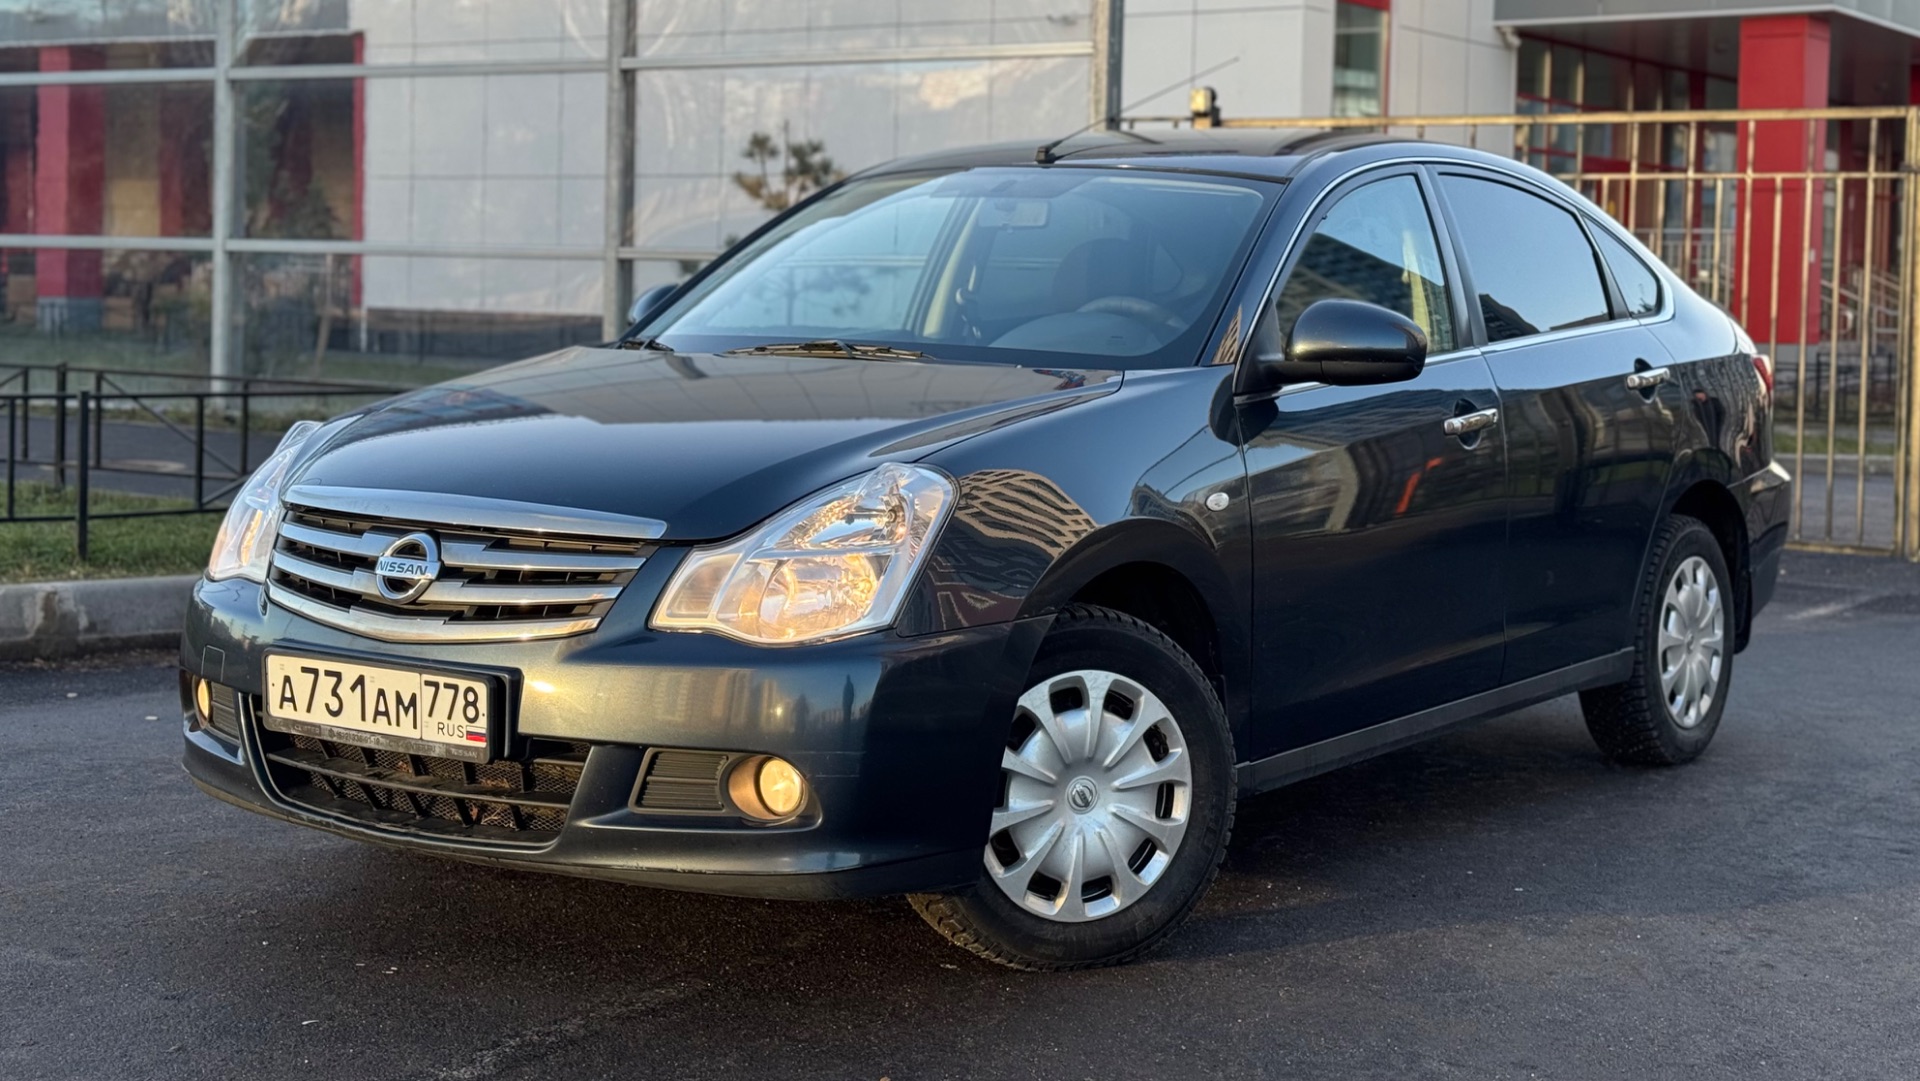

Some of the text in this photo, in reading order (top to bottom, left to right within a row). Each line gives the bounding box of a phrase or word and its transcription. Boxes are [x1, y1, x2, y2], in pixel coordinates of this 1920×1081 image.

[378, 560, 428, 576] NISSAN
[279, 666, 480, 730] A731AM 778
[437, 721, 465, 739] RUS
